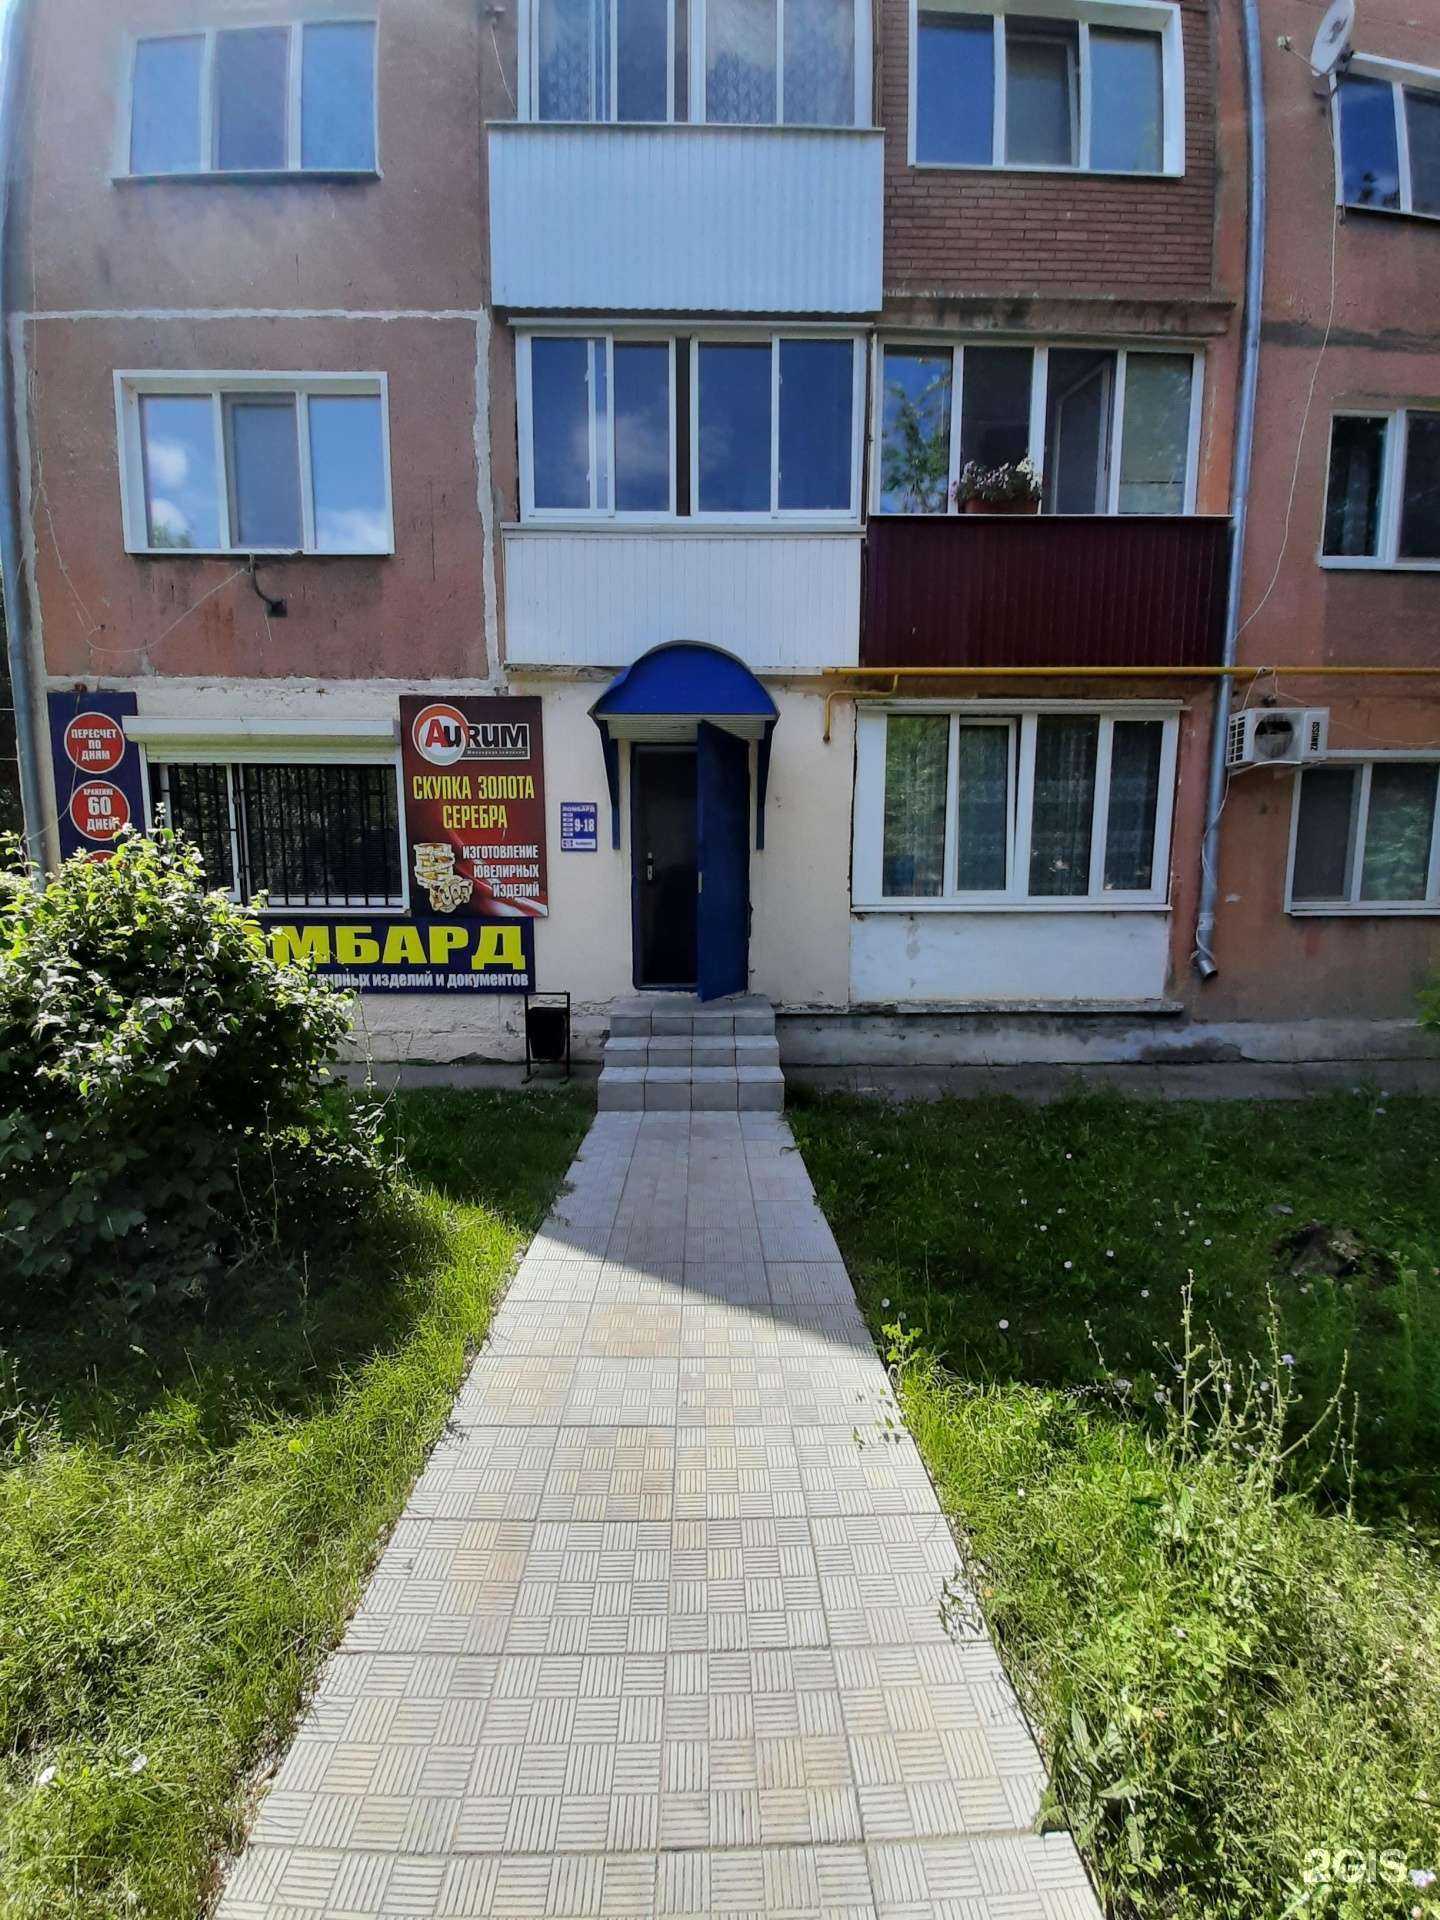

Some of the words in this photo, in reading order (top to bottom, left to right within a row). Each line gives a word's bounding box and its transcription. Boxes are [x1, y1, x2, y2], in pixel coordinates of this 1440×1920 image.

[71, 729, 117, 739] ПЕРЕСЧЕТ
[88, 740, 101, 750] ПО
[81, 750, 110, 761] ДНЯМ
[412, 775, 472, 800] СКУПКА
[478, 775, 535, 799] ЗОЛОТА
[88, 796, 112, 816] 60
[443, 805, 508, 829] СЕРЕБРА
[574, 818, 595, 832] 9-18
[462, 845, 539, 860] ИЗГОТОВЛЕНИЕ
[473, 864, 539, 878] ЮВЕЛИРНЫХ
[493, 881, 540, 899] ИЗДЕЛИЙ
[241, 924, 526, 971] МБАРД
[372, 970, 433, 989] изделий
[435, 973, 445, 987] и
[446, 973, 529, 989] документов
